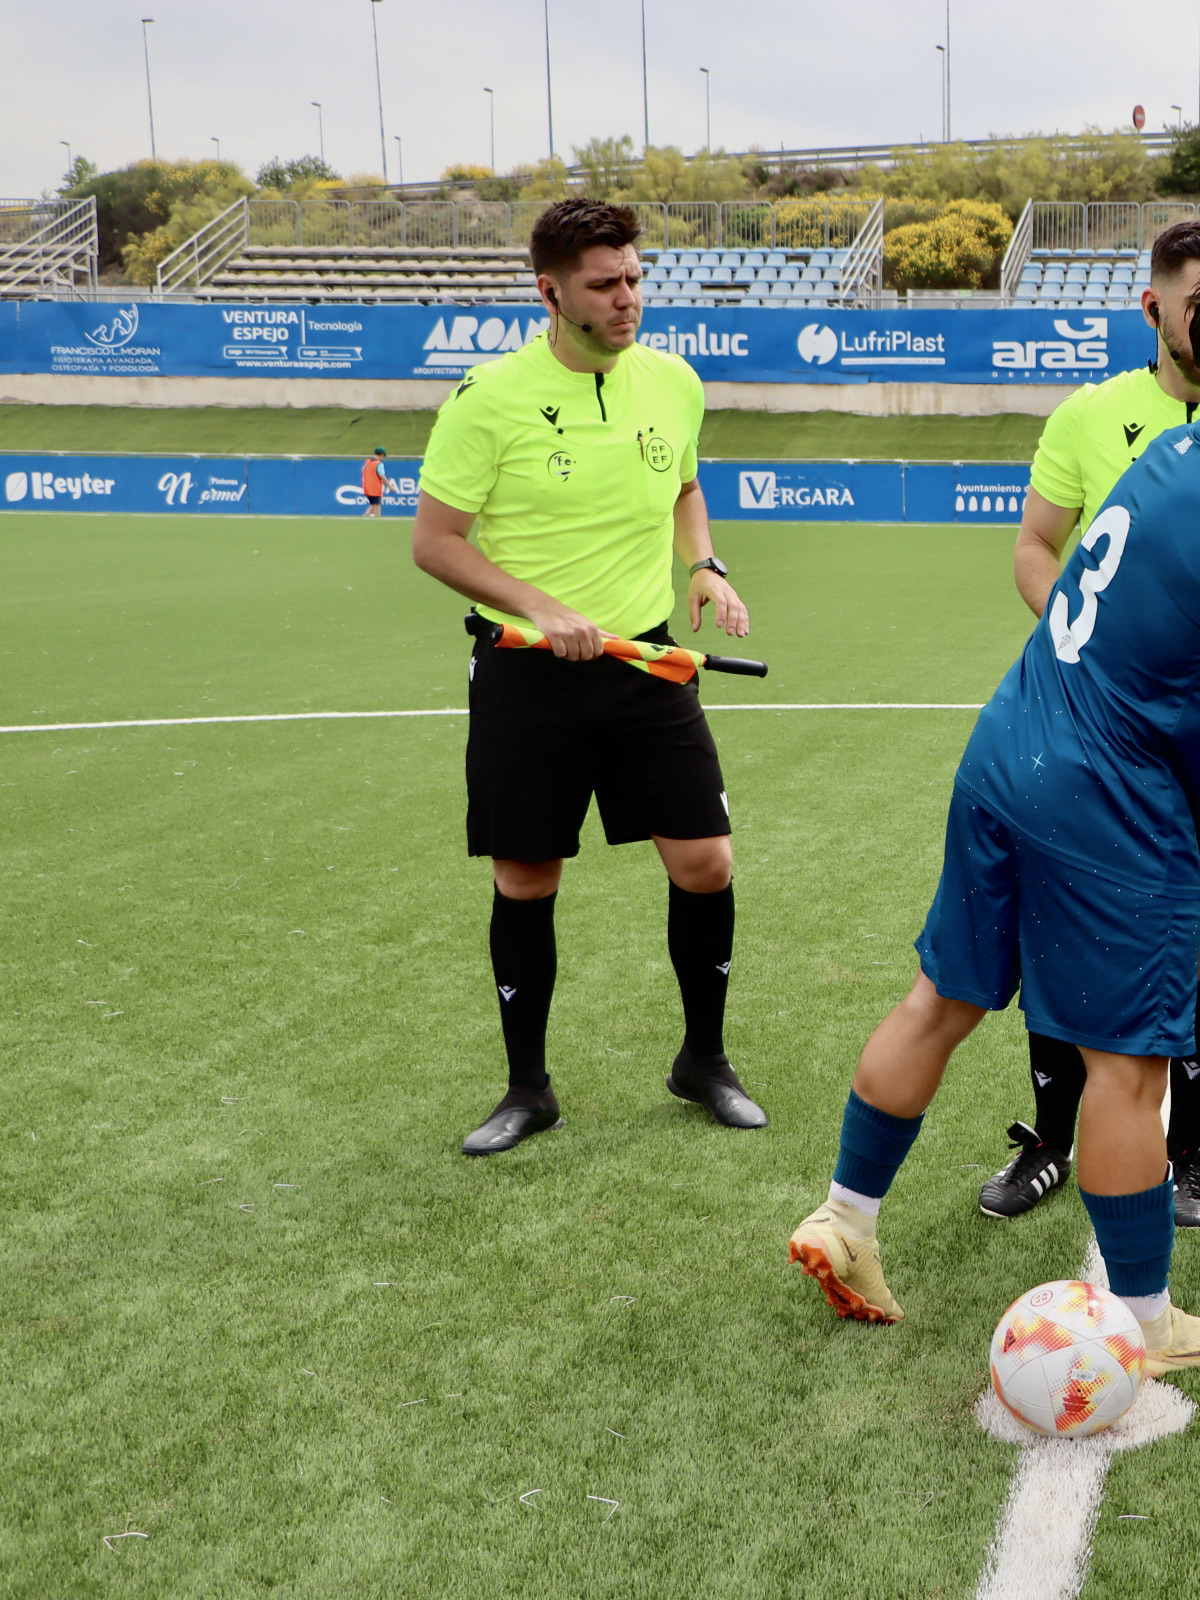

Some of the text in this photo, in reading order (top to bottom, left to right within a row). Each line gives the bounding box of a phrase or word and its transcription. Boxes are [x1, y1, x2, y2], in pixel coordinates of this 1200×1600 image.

[223, 311, 299, 324] VENTURA
[308, 321, 362, 333] Tecnología
[233, 327, 289, 343] ESPEJO
[841, 330, 945, 352] LufriPlast
[51, 346, 110, 355] FRANCISCO
[992, 341, 1109, 369] aras
[236, 360, 352, 369] www.venturaespejo.com
[413, 367, 463, 375] ARQUITECTURA
[32, 472, 115, 500] Keyter
[745, 476, 855, 506] VERGARA
[956, 484, 1022, 495] Ayuntamiento
[1049, 505, 1131, 664] 3
